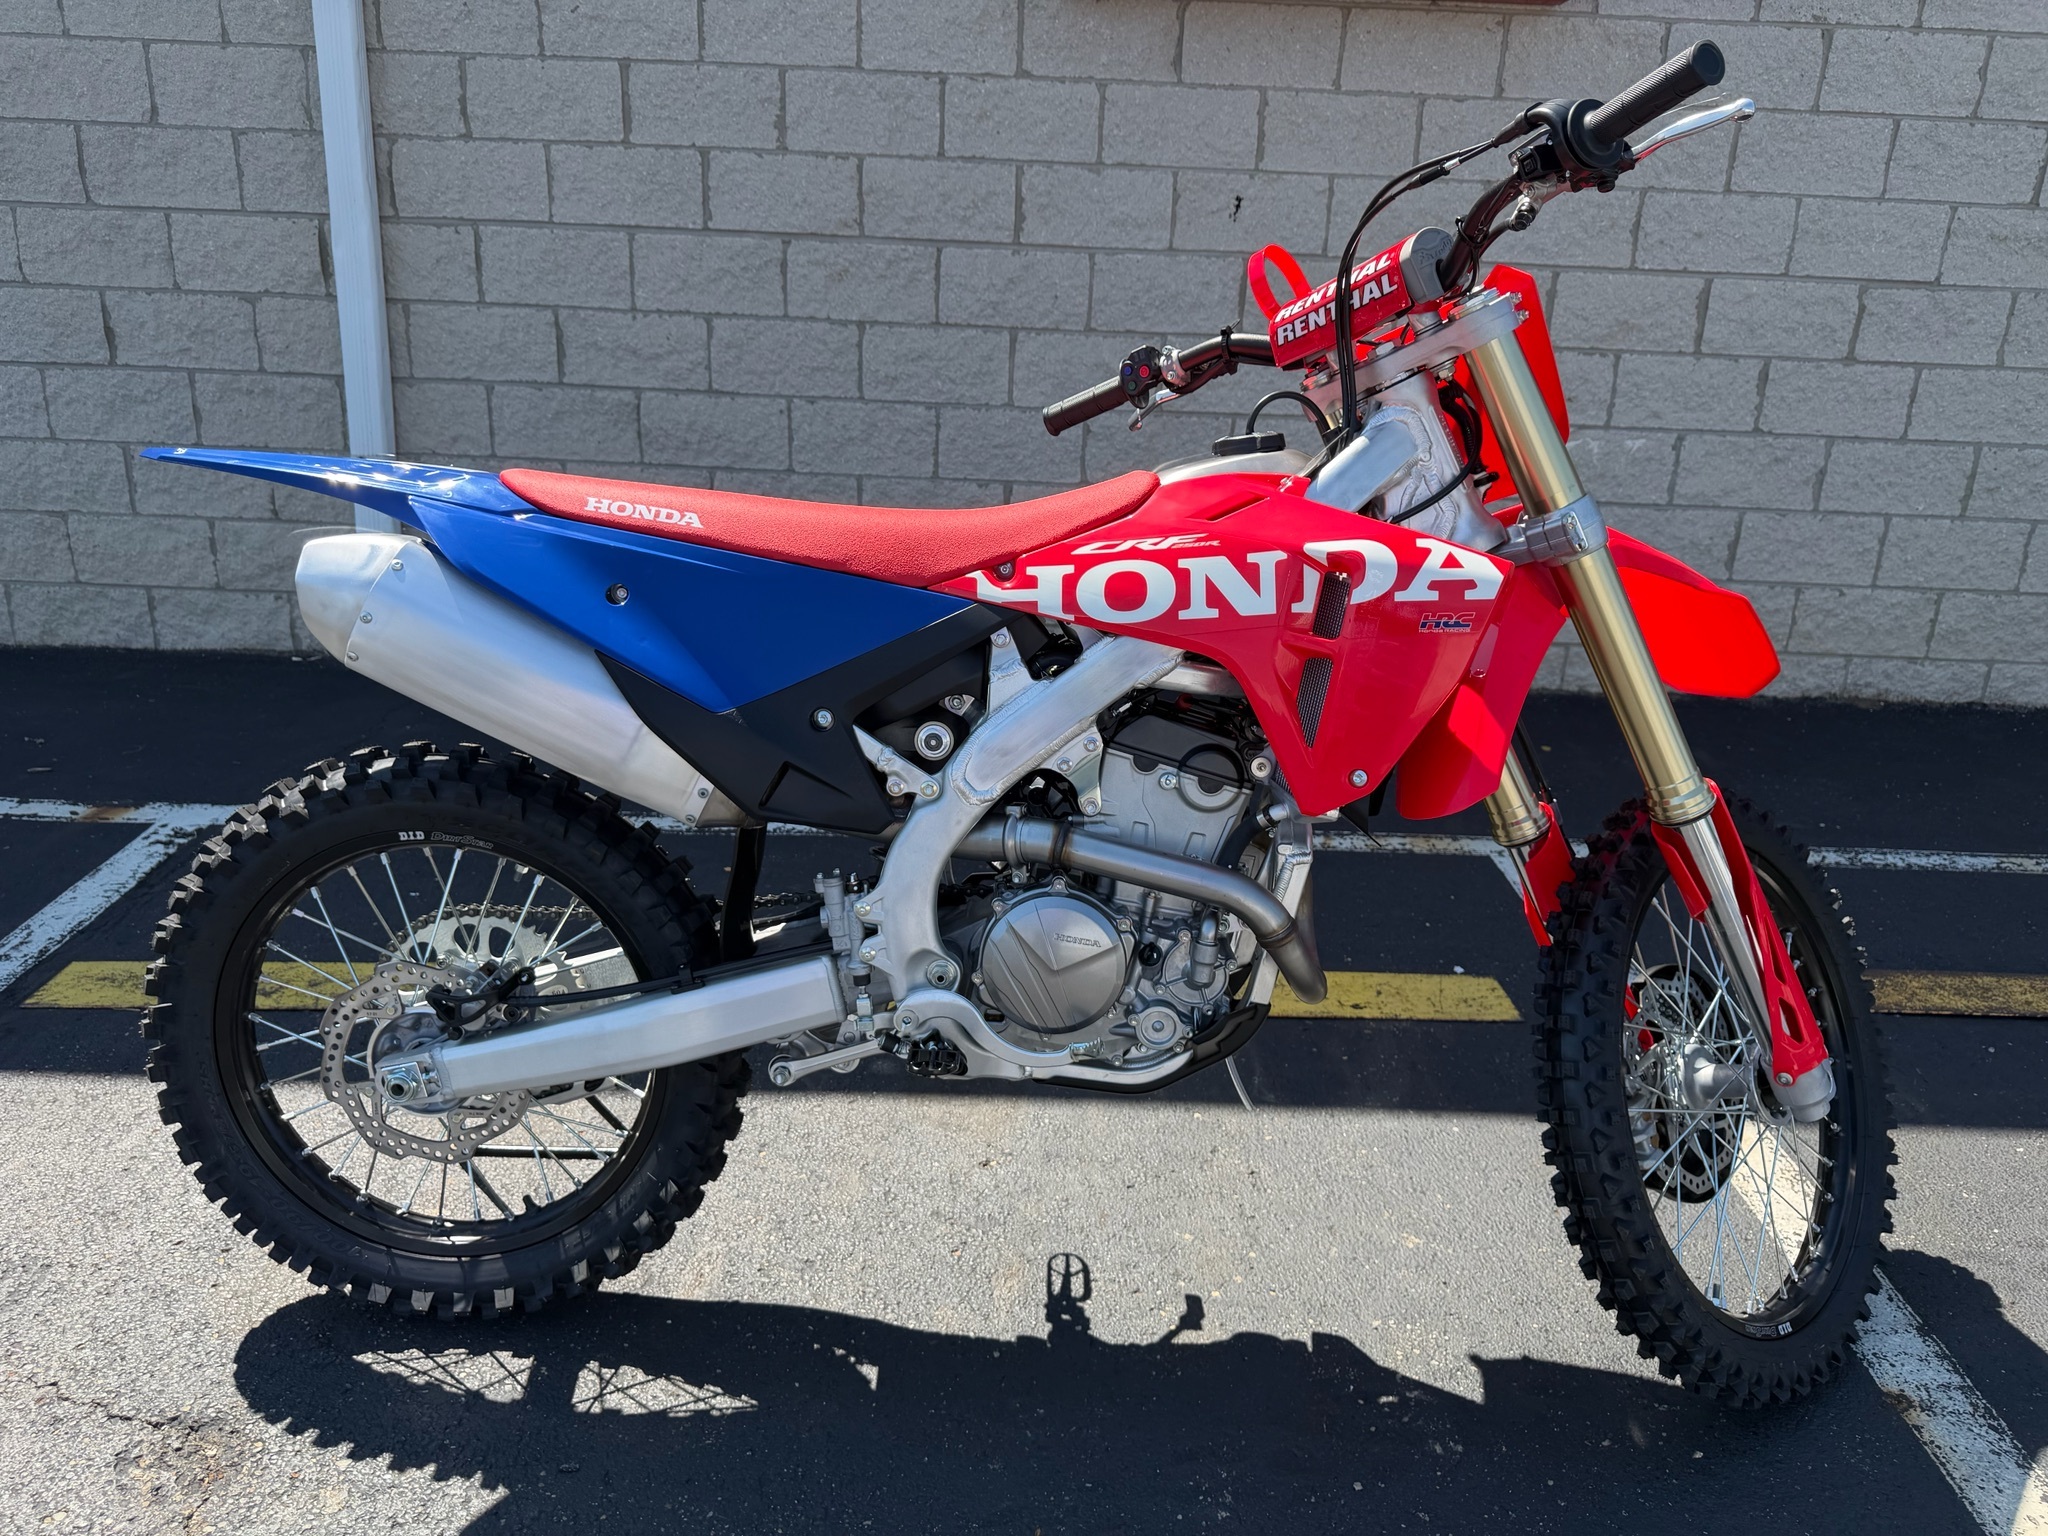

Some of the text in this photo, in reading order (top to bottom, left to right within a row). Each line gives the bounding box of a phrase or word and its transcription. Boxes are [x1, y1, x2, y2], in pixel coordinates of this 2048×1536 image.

[584, 497, 704, 528] HONDA
[1071, 533, 1209, 554] CRF
[965, 538, 1505, 624] HONDA
[1419, 612, 1476, 629] HRC
[1053, 932, 1102, 948] HONDA
